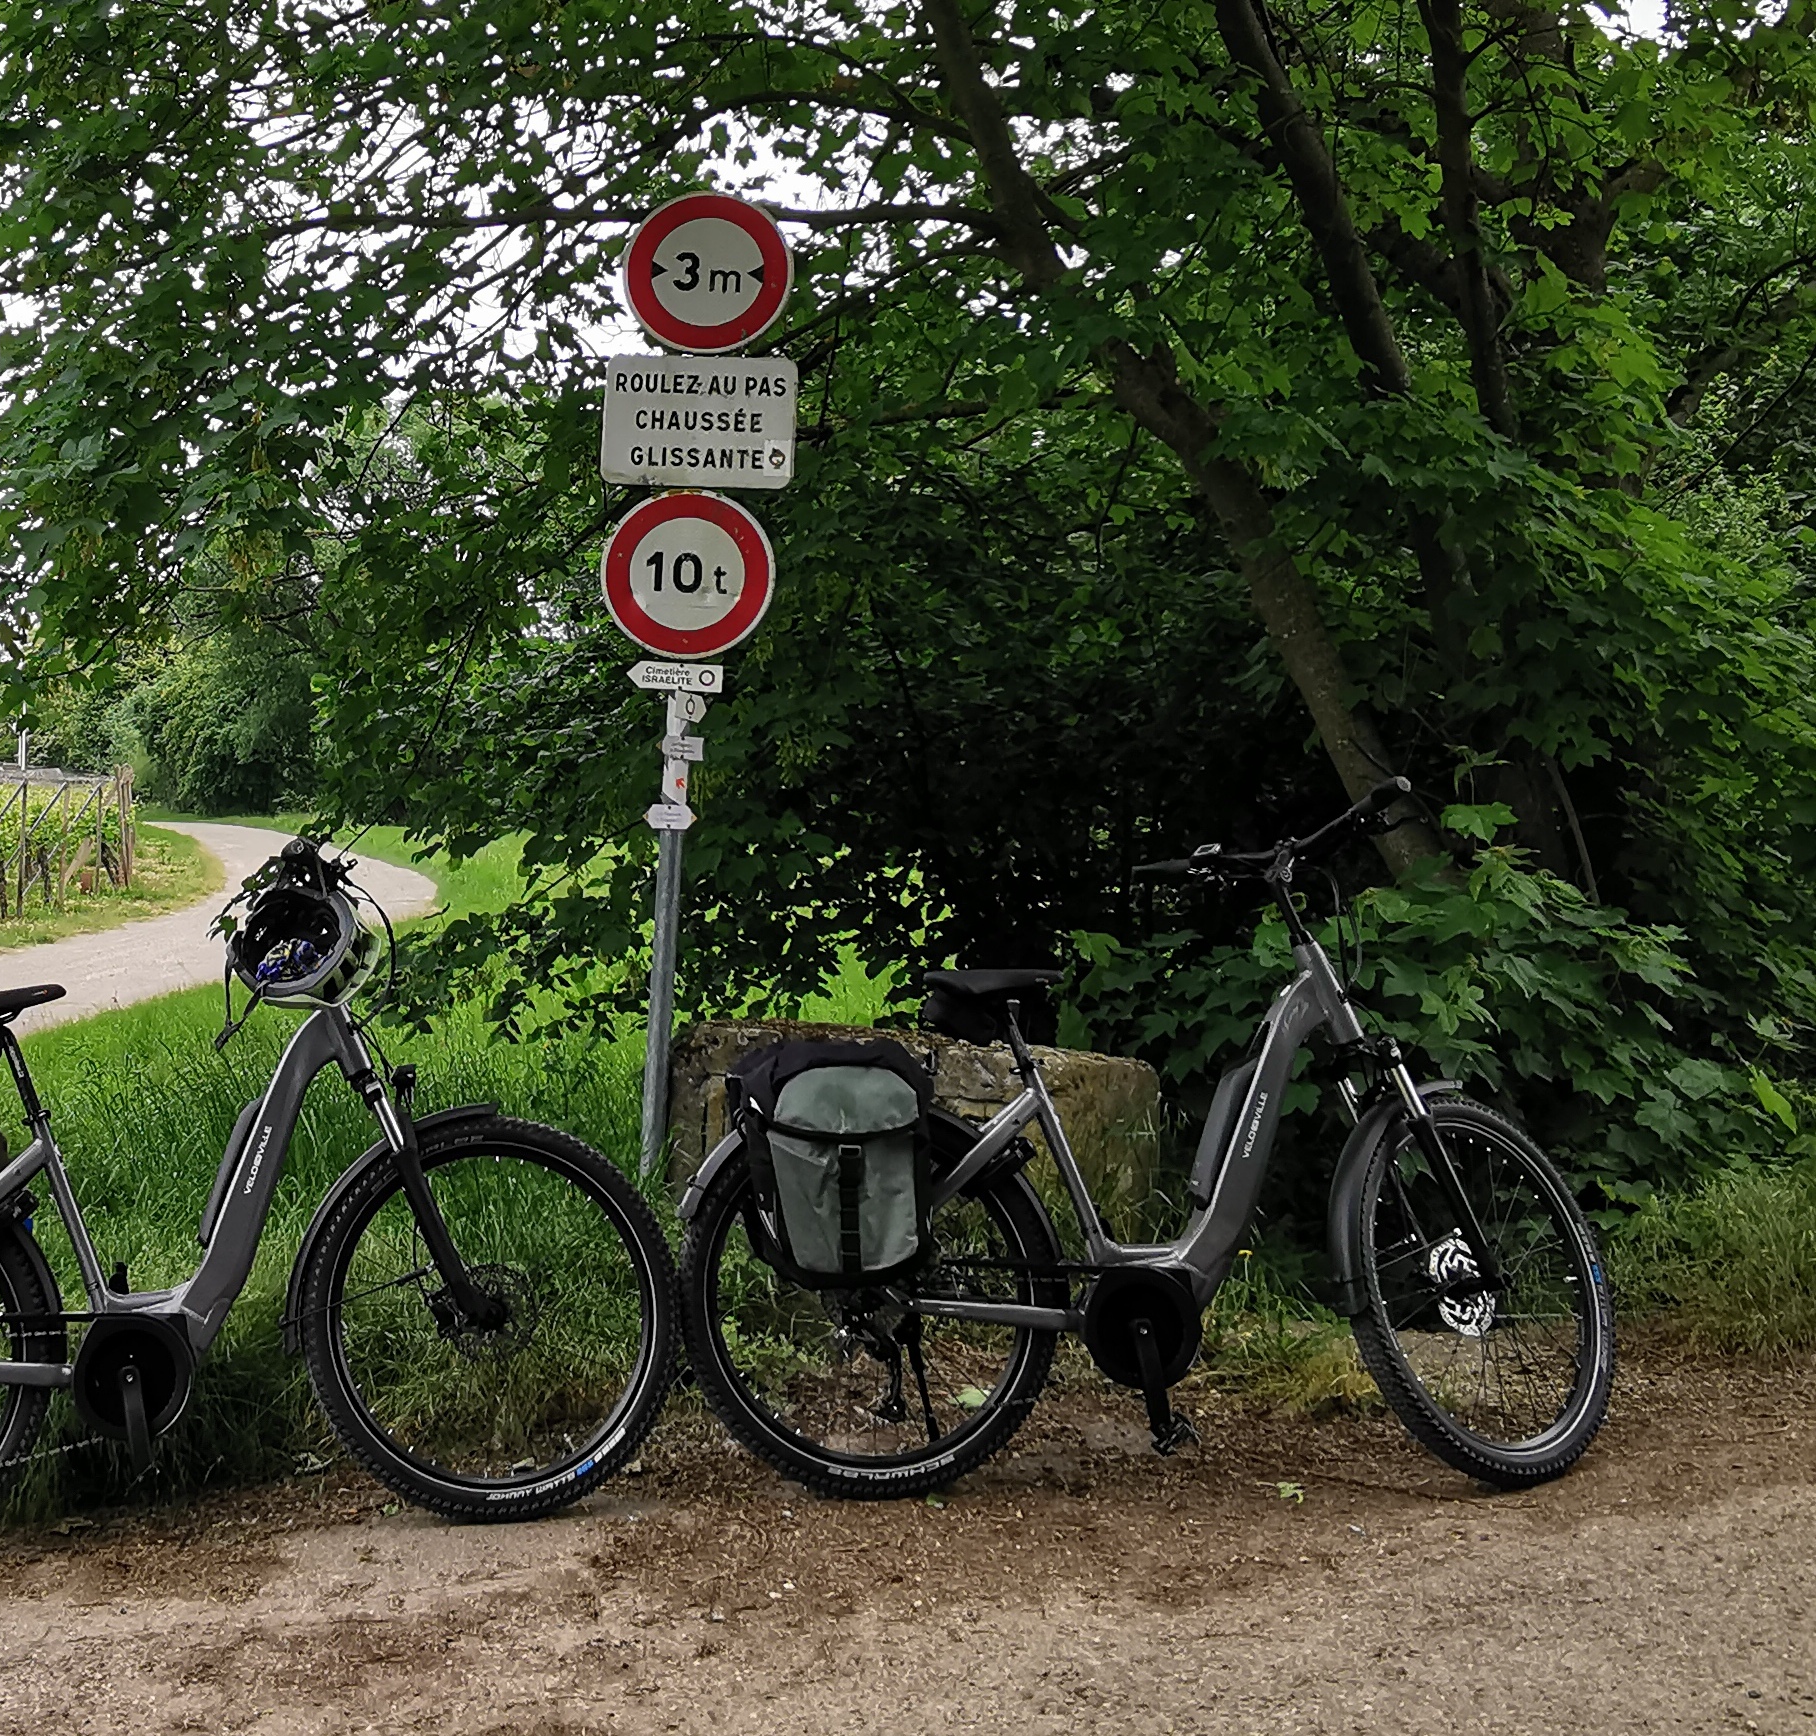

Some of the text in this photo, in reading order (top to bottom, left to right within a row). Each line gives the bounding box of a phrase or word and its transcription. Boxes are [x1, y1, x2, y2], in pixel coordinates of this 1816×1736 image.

[673, 252, 742, 294] 3 m
[615, 373, 787, 397] ROULEZ AU PAS
[635, 408, 763, 432] CHAUSSÉE
[630, 446, 764, 470] GLISSANTE
[646, 552, 727, 595] 10 t
[645, 666, 691, 677] Cimetière
